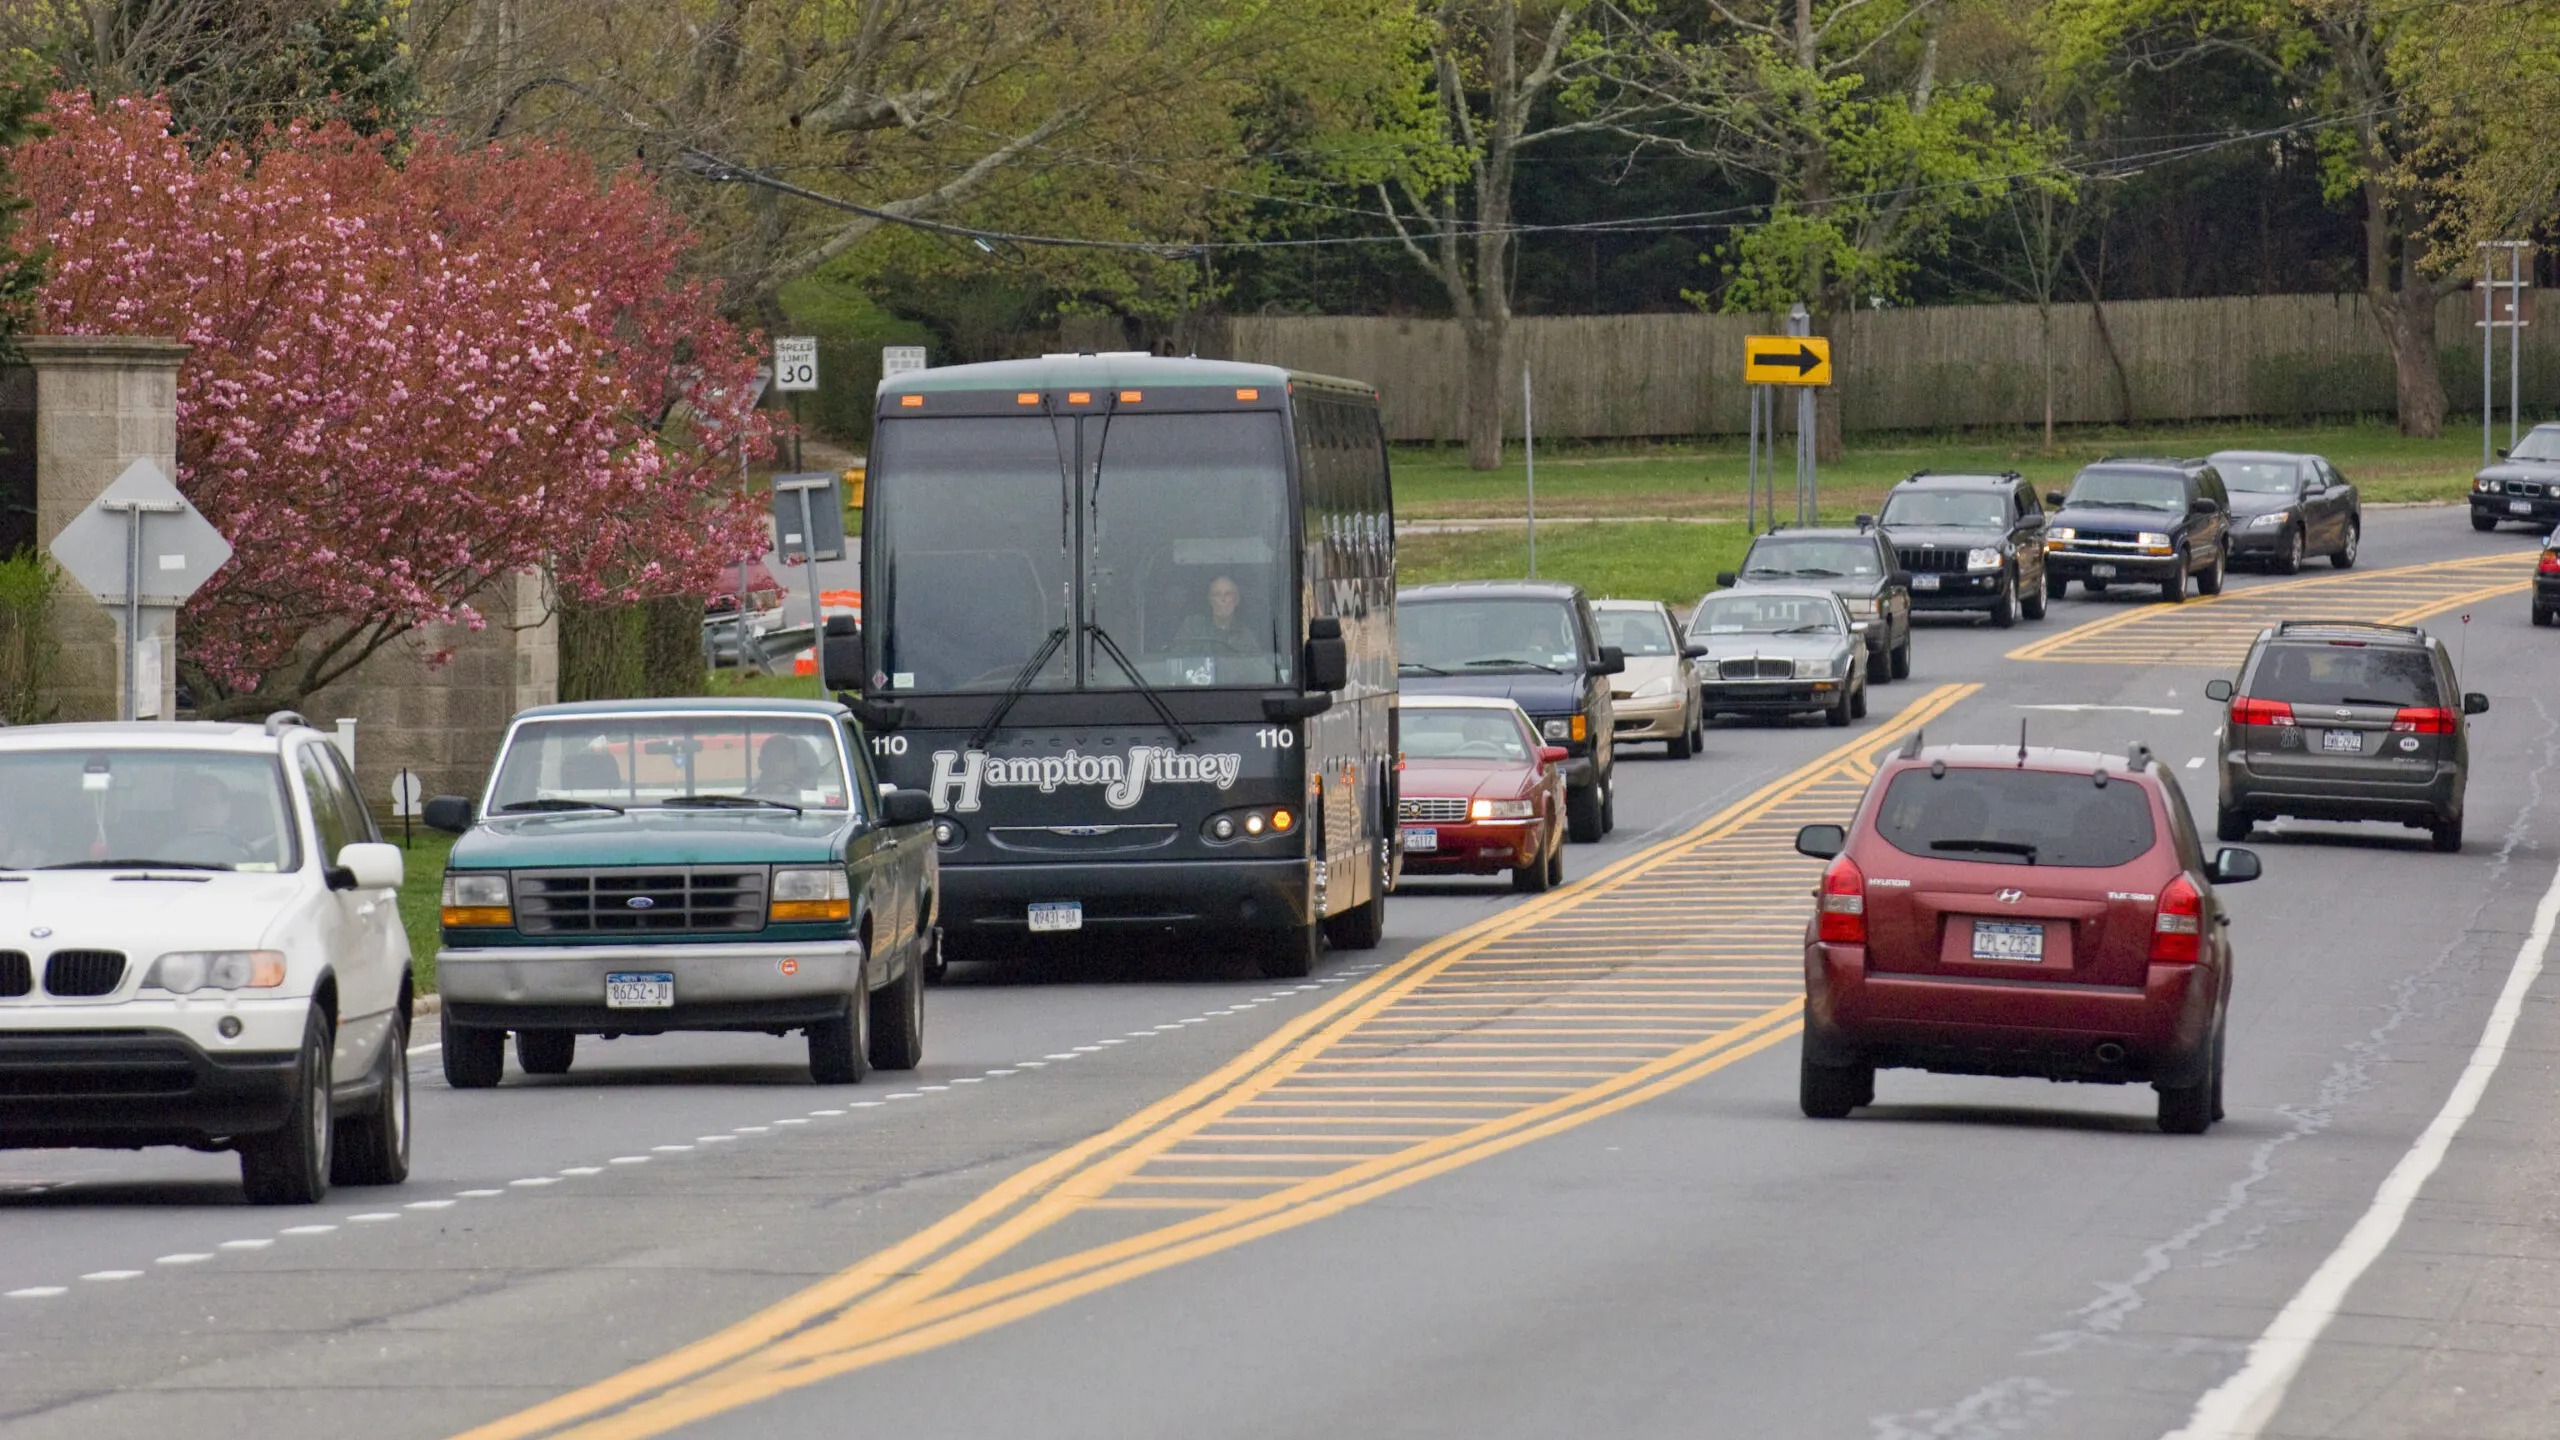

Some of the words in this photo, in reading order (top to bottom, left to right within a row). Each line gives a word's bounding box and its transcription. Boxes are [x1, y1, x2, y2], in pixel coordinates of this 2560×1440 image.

[779, 342, 813, 352] SPEED
[782, 354, 809, 362] LIMIT
[781, 364, 813, 383] 30
[1256, 728, 1294, 748] 110
[871, 735, 908, 755] 110
[1868, 878, 1911, 887] HYUNDAI
[2107, 891, 2156, 901] TUCSON
